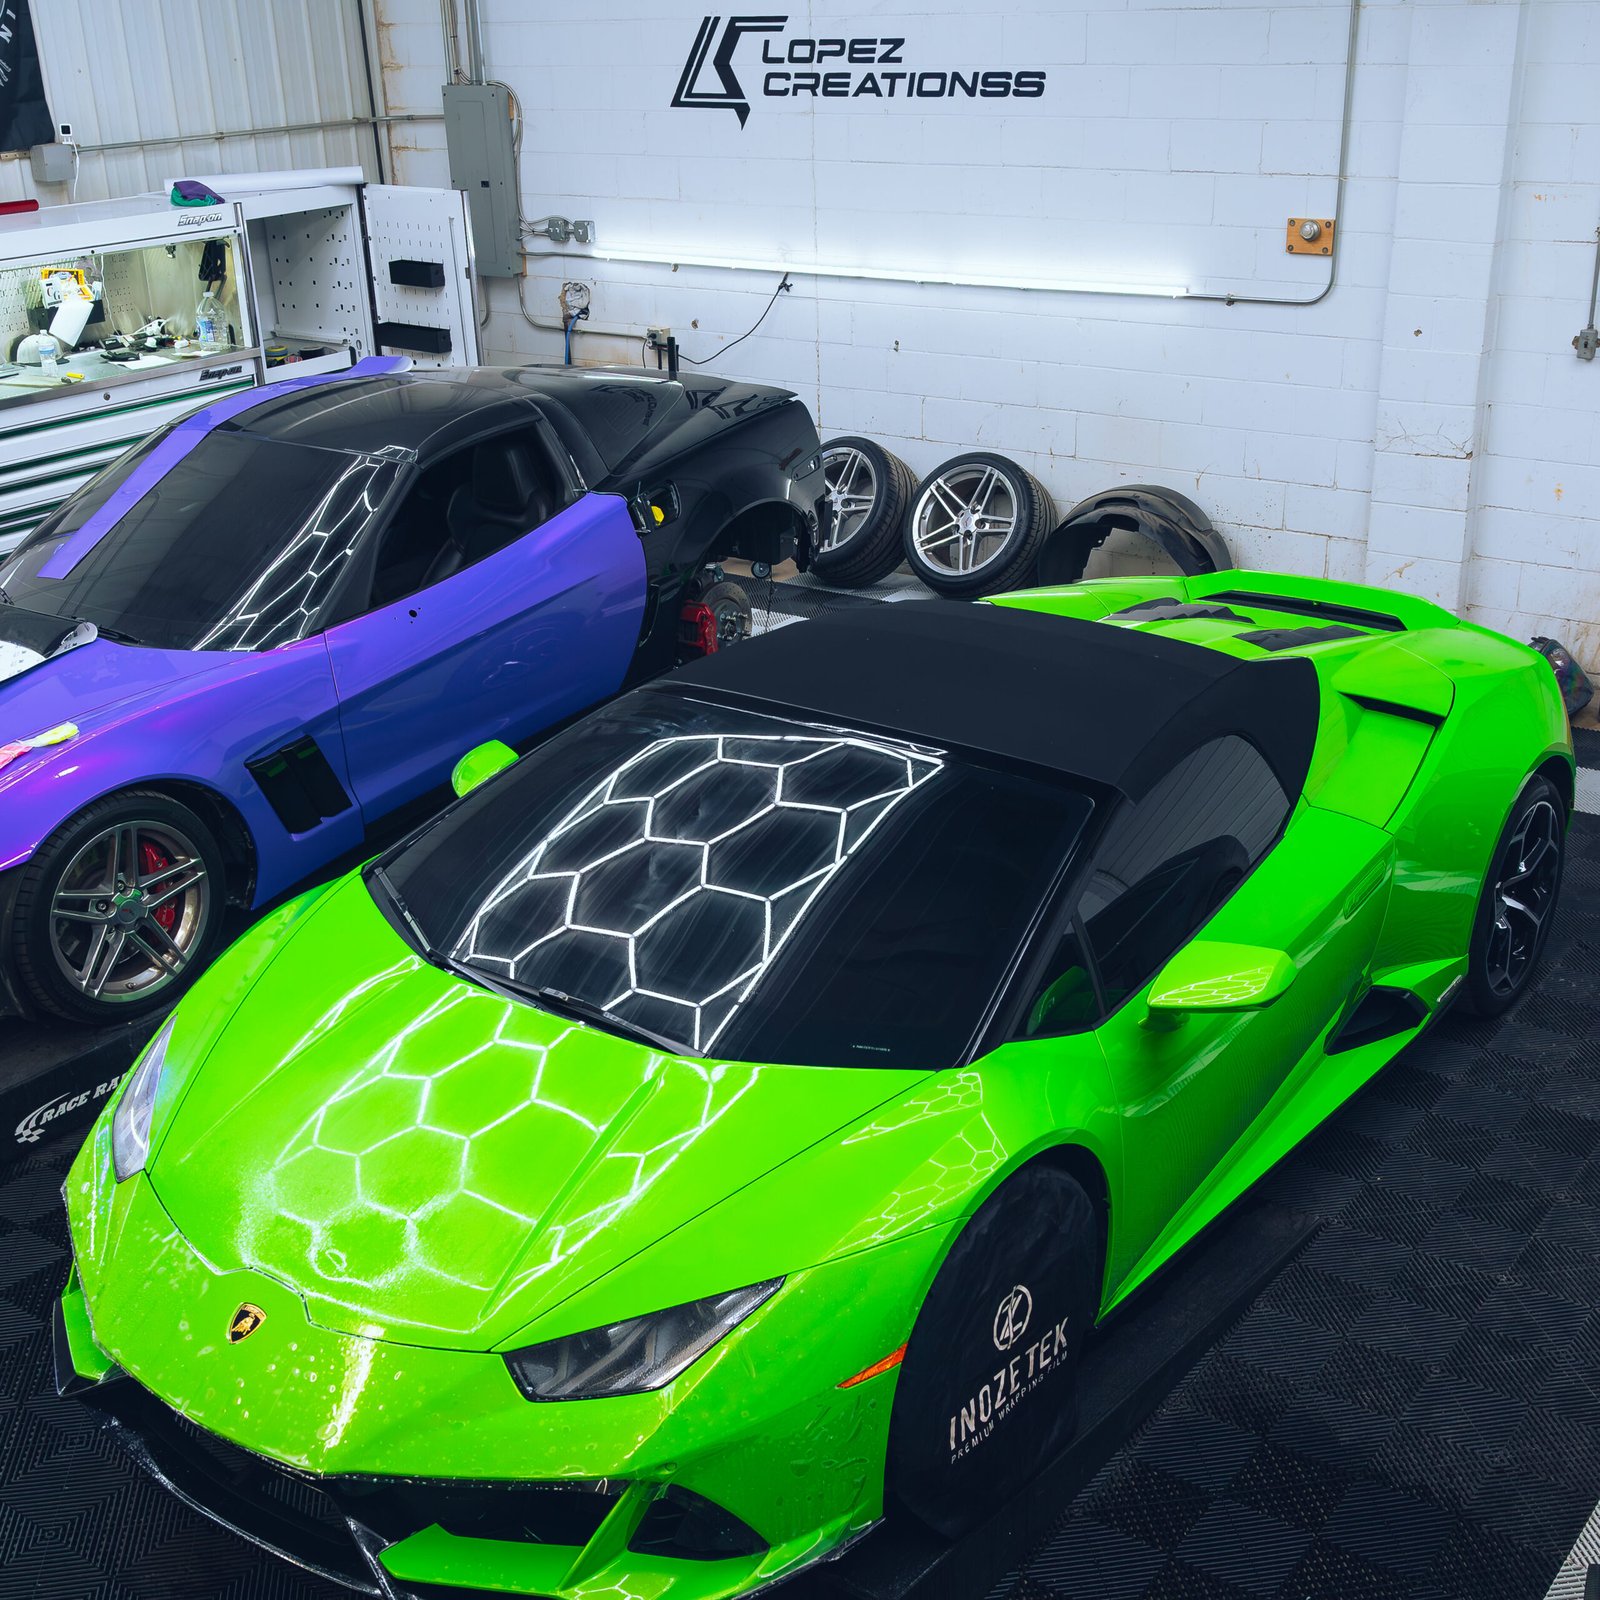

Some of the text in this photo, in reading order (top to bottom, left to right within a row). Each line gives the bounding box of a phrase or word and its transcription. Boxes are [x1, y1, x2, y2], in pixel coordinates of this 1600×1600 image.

[762, 38, 905, 64] LOPEZ
[763, 71, 1046, 97] CREATIONSS
[40, 1072, 128, 1125] RACE RA
[951, 1419, 994, 1464] PREMIUM
[998, 1374, 1044, 1420] WRAPPING
